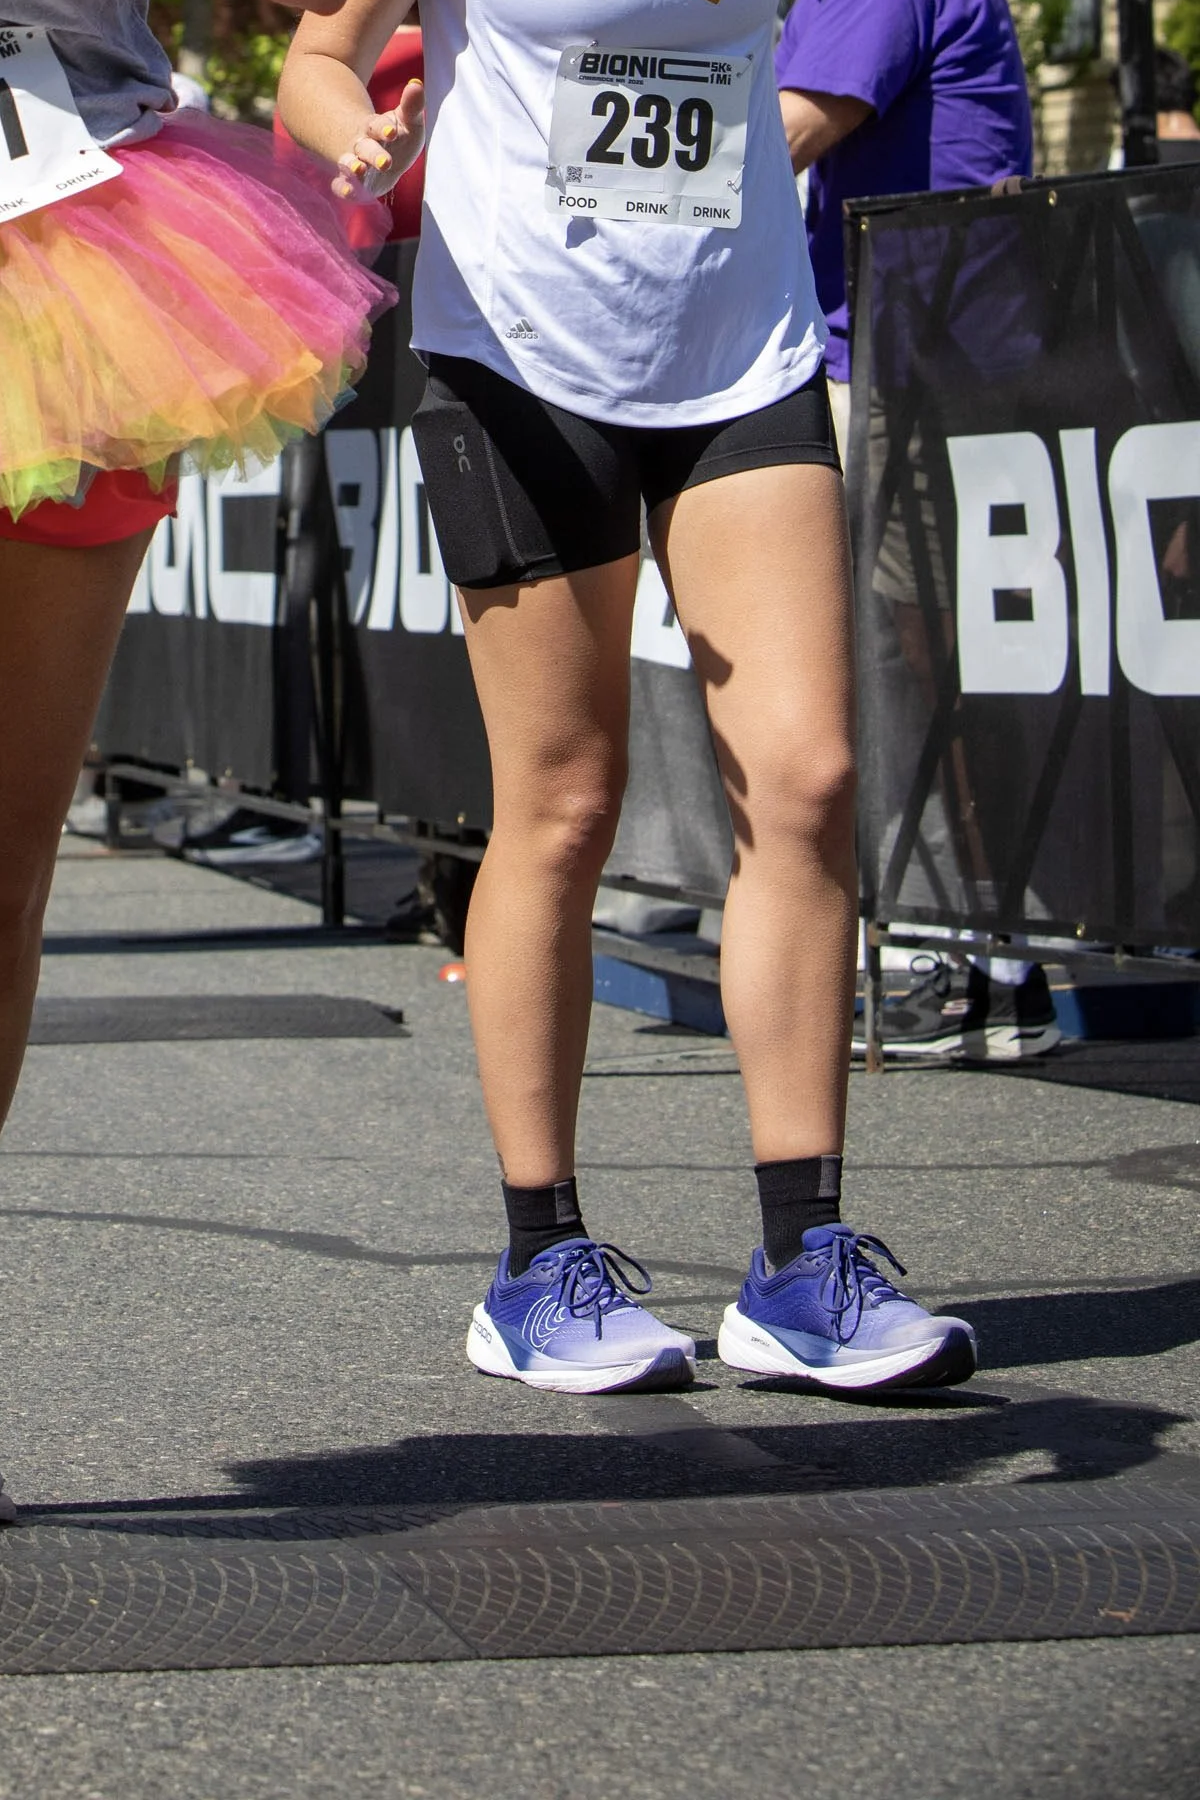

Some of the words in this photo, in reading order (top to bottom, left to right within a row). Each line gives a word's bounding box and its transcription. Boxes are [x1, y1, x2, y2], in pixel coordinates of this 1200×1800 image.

[580, 53, 711, 83] BIONIC
[586, 90, 714, 172] 239
[55, 167, 106, 191] DRINK
[558, 196, 598, 210] FOOD
[626, 201, 669, 216] DRINK
[693, 206, 731, 220] DRINK
[505, 331, 539, 339] adidas
